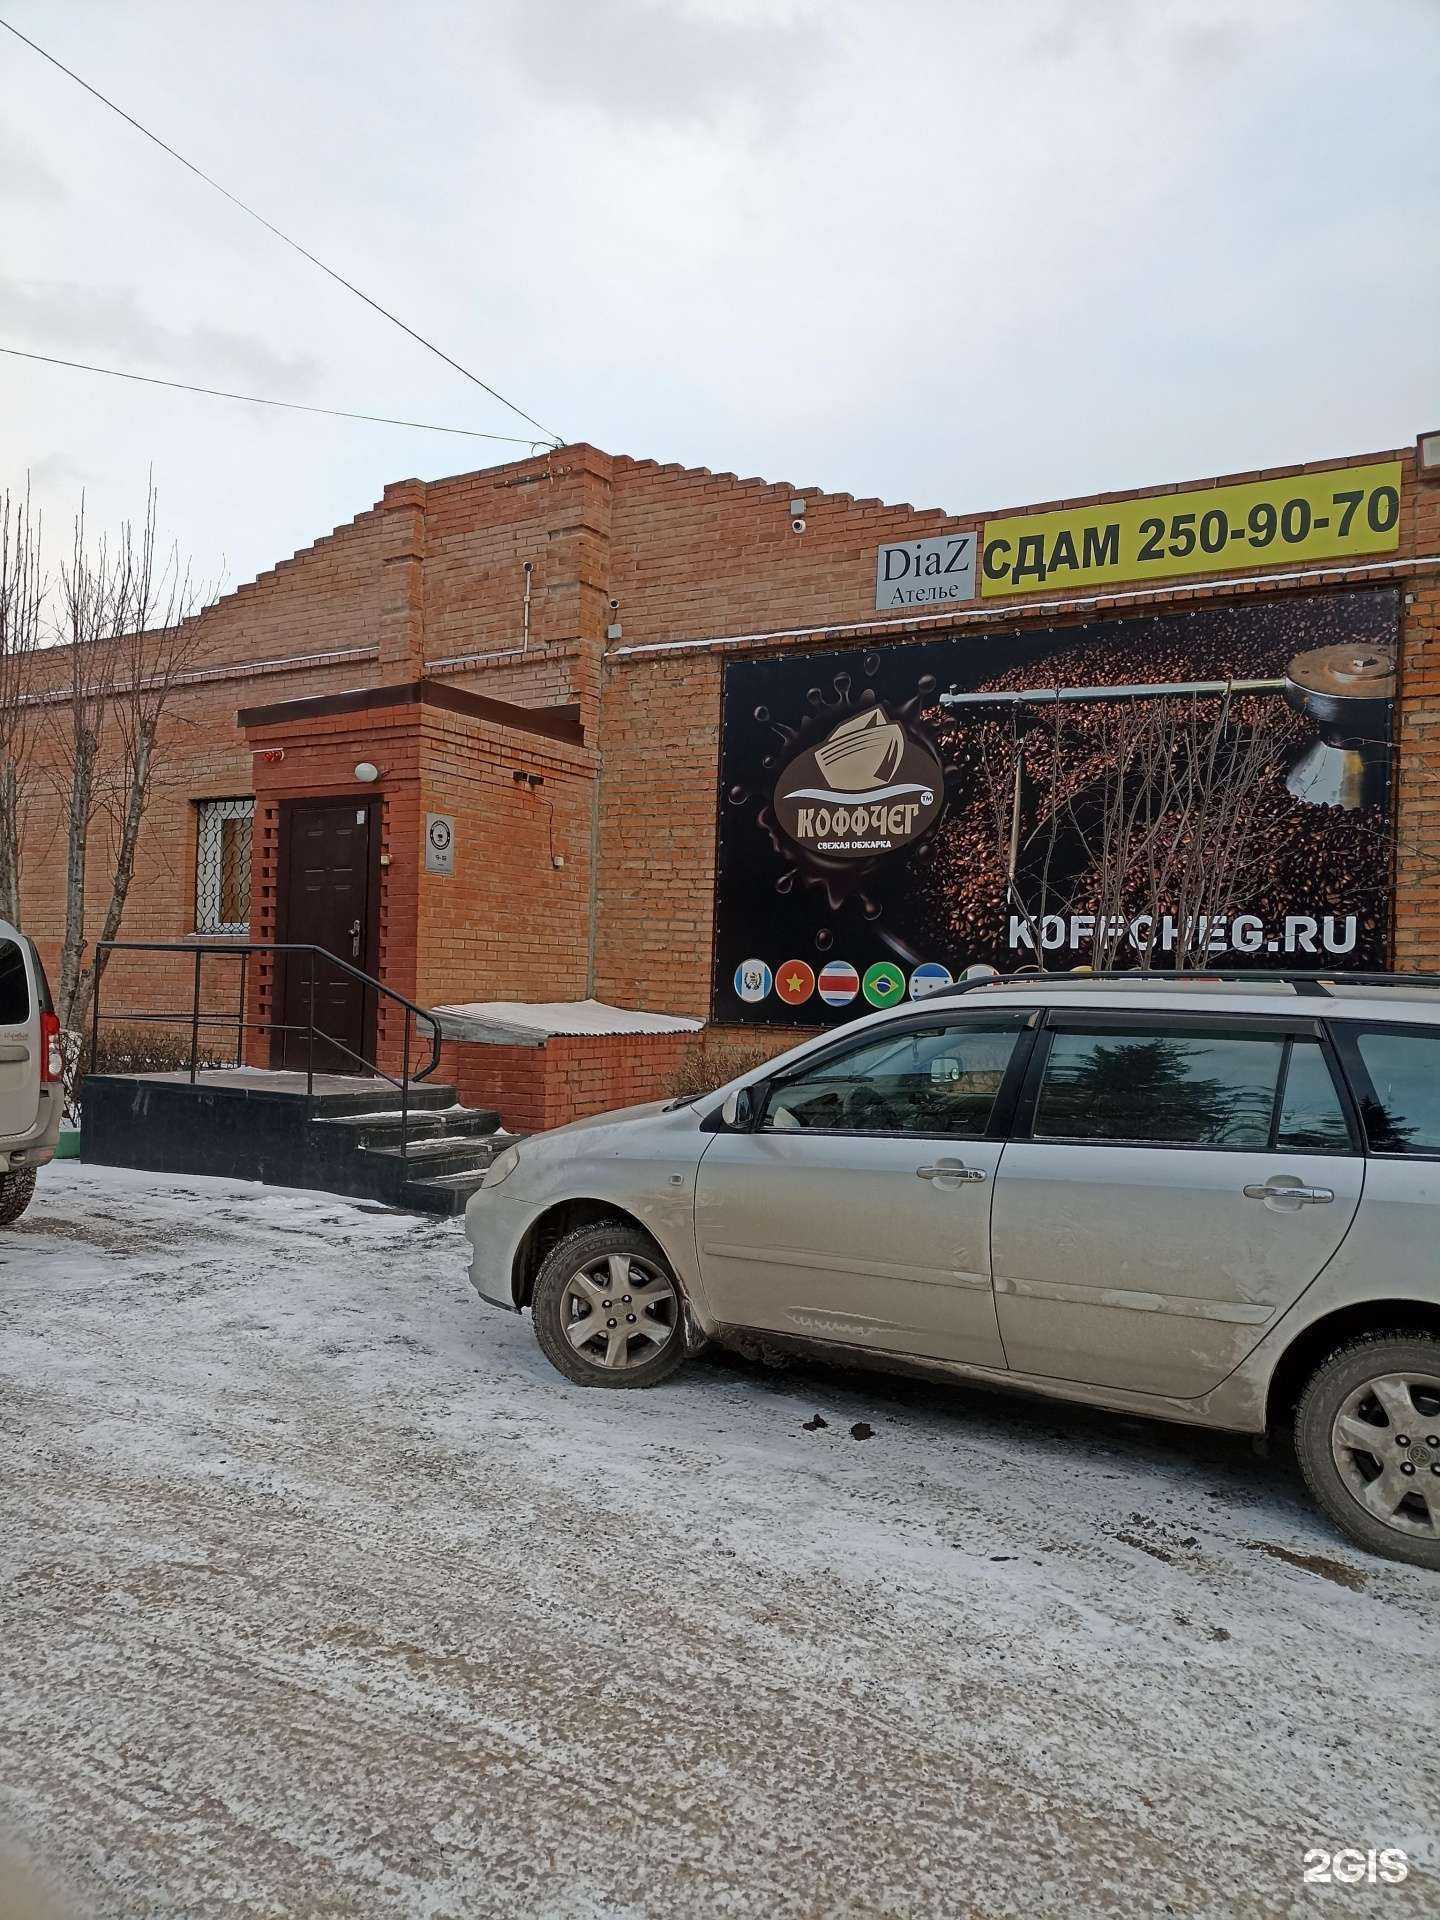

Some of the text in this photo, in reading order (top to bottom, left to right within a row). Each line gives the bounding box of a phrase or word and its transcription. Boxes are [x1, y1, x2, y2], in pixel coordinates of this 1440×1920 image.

[983, 486, 1399, 584] СДАМ 250-90-70
[883, 539, 969, 581] DiaZ
[891, 584, 958, 604] Ателье
[797, 804, 919, 837] КОФФЧЕГ
[817, 840, 892, 850] СВЕЖАЯ ОБЖАРКА
[1008, 915, 1357, 953] KOFFCHEG.RU
